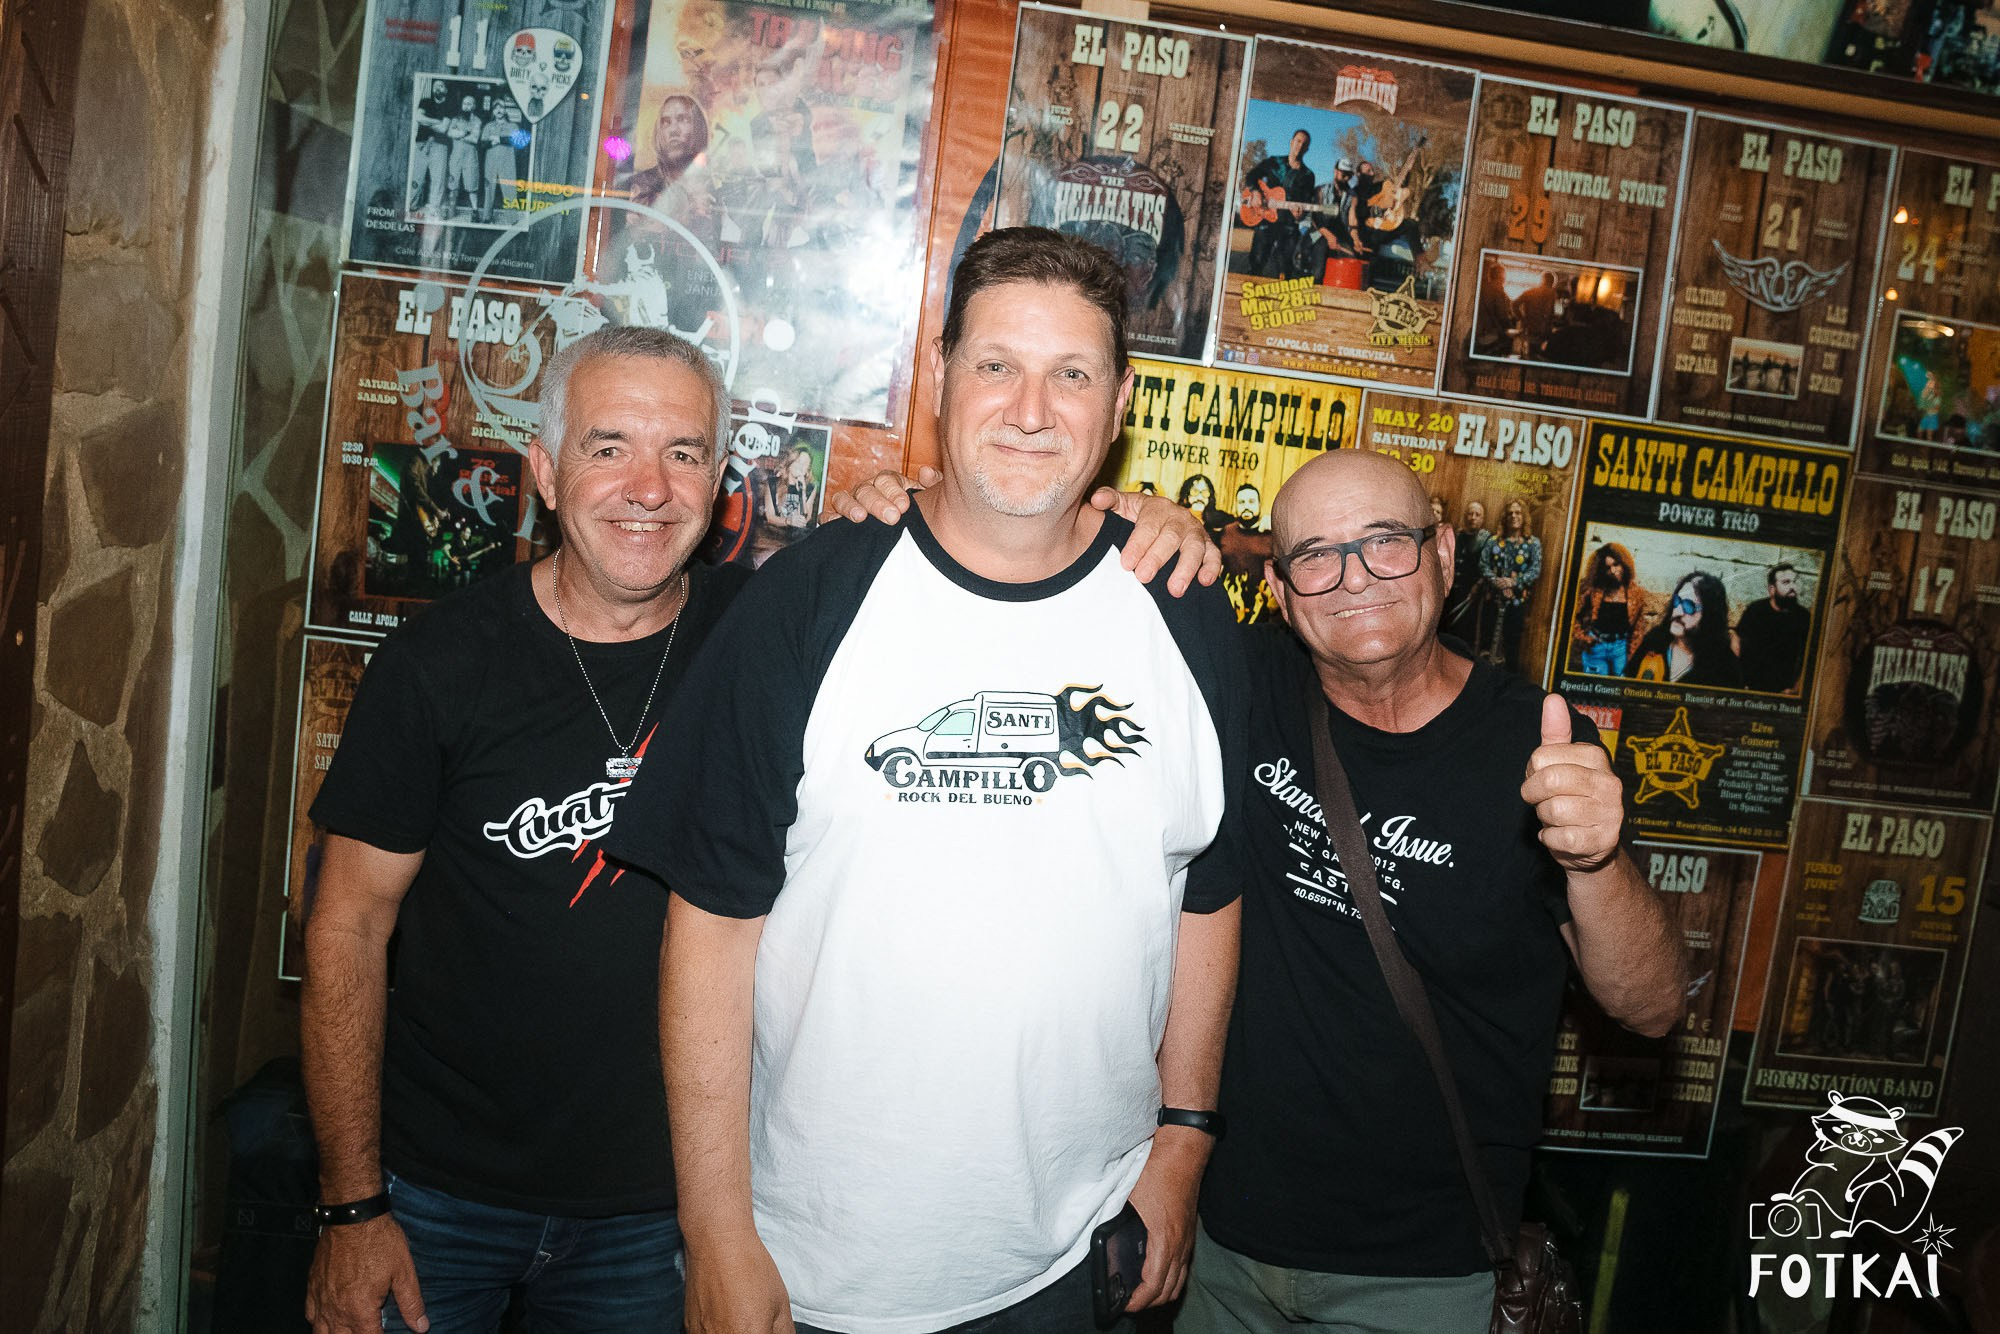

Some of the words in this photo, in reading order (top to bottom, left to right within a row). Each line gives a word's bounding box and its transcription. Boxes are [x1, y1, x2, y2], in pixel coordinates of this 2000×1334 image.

[446, 15, 489, 70] 11
[1071, 25, 1107, 67] EL
[1121, 32, 1191, 80] PASO
[1096, 100, 1145, 153] 22
[1527, 95, 1560, 137] EL
[1572, 102, 1637, 149] PASO
[1740, 132, 1771, 173] EL
[1783, 139, 1843, 184] PASO
[1100, 176, 1126, 188] THE
[1543, 167, 1612, 200] CONTROL
[1618, 179, 1667, 208] STONE
[1944, 165, 1975, 207] EL
[365, 219, 396, 232] DESDE
[398, 223, 416, 234] LAS
[367, 206, 395, 218] FROM
[1055, 182, 1167, 245] HELLHATES
[1508, 193, 1551, 244] 29
[1763, 203, 1801, 251] 21
[500, 257, 536, 271] Alicante
[1897, 232, 1940, 284] 24
[1240, 298, 1274, 317] MAY
[1279, 290, 1322, 313] 28TH
[1242, 276, 1316, 299] SATURDAY
[395, 289, 433, 336] EL
[1250, 308, 1317, 331] 9:00PM
[357, 377, 411, 394] SATURDAY
[357, 392, 397, 405] SABADO
[1184, 381, 1347, 452] CAMPILLO
[1372, 407, 1424, 433] MAY,
[1427, 412, 1454, 434] 20
[395, 360, 458, 466] Bar
[452, 466, 504, 527] &
[1146, 440, 1210, 467] POWER
[1219, 446, 1259, 472] TRÍO
[1372, 431, 1447, 452] SATURDAY
[1453, 413, 1490, 458] EL
[1494, 418, 1574, 468] PASO
[1593, 433, 1686, 497] SANTI
[1691, 446, 1839, 516] CAMPILLO
[1658, 500, 1715, 528] POWER
[1722, 508, 1760, 532] TRÍO
[1892, 490, 1923, 532] EL
[1935, 496, 1997, 541] PASO
[1912, 565, 1954, 614] 17
[349, 610, 373, 625] CALLE
[375, 613, 399, 628] APOLO
[1559, 681, 1592, 694] Special
[1866, 645, 1969, 705] HELLHATES
[986, 711, 1051, 729] SANTI
[882, 755, 1057, 793] CAMPILLO
[1645, 752, 1661, 771] EL
[1670, 753, 1703, 777] PASO
[898, 791, 941, 803] ROCK
[948, 792, 977, 804] DEL
[983, 793, 1033, 806] BUENO
[1293, 820, 1321, 840] NEW
[1372, 815, 1455, 869] Issue.
[1841, 812, 1874, 853] EL
[1876, 816, 1946, 859] PASO
[1648, 853, 1708, 894] PASO
[1914, 873, 1967, 916] 15
[1687, 1012, 1696, 1030] 6
[1701, 1018, 1712, 1032] €
[1883, 1077, 1935, 1099] BAND
